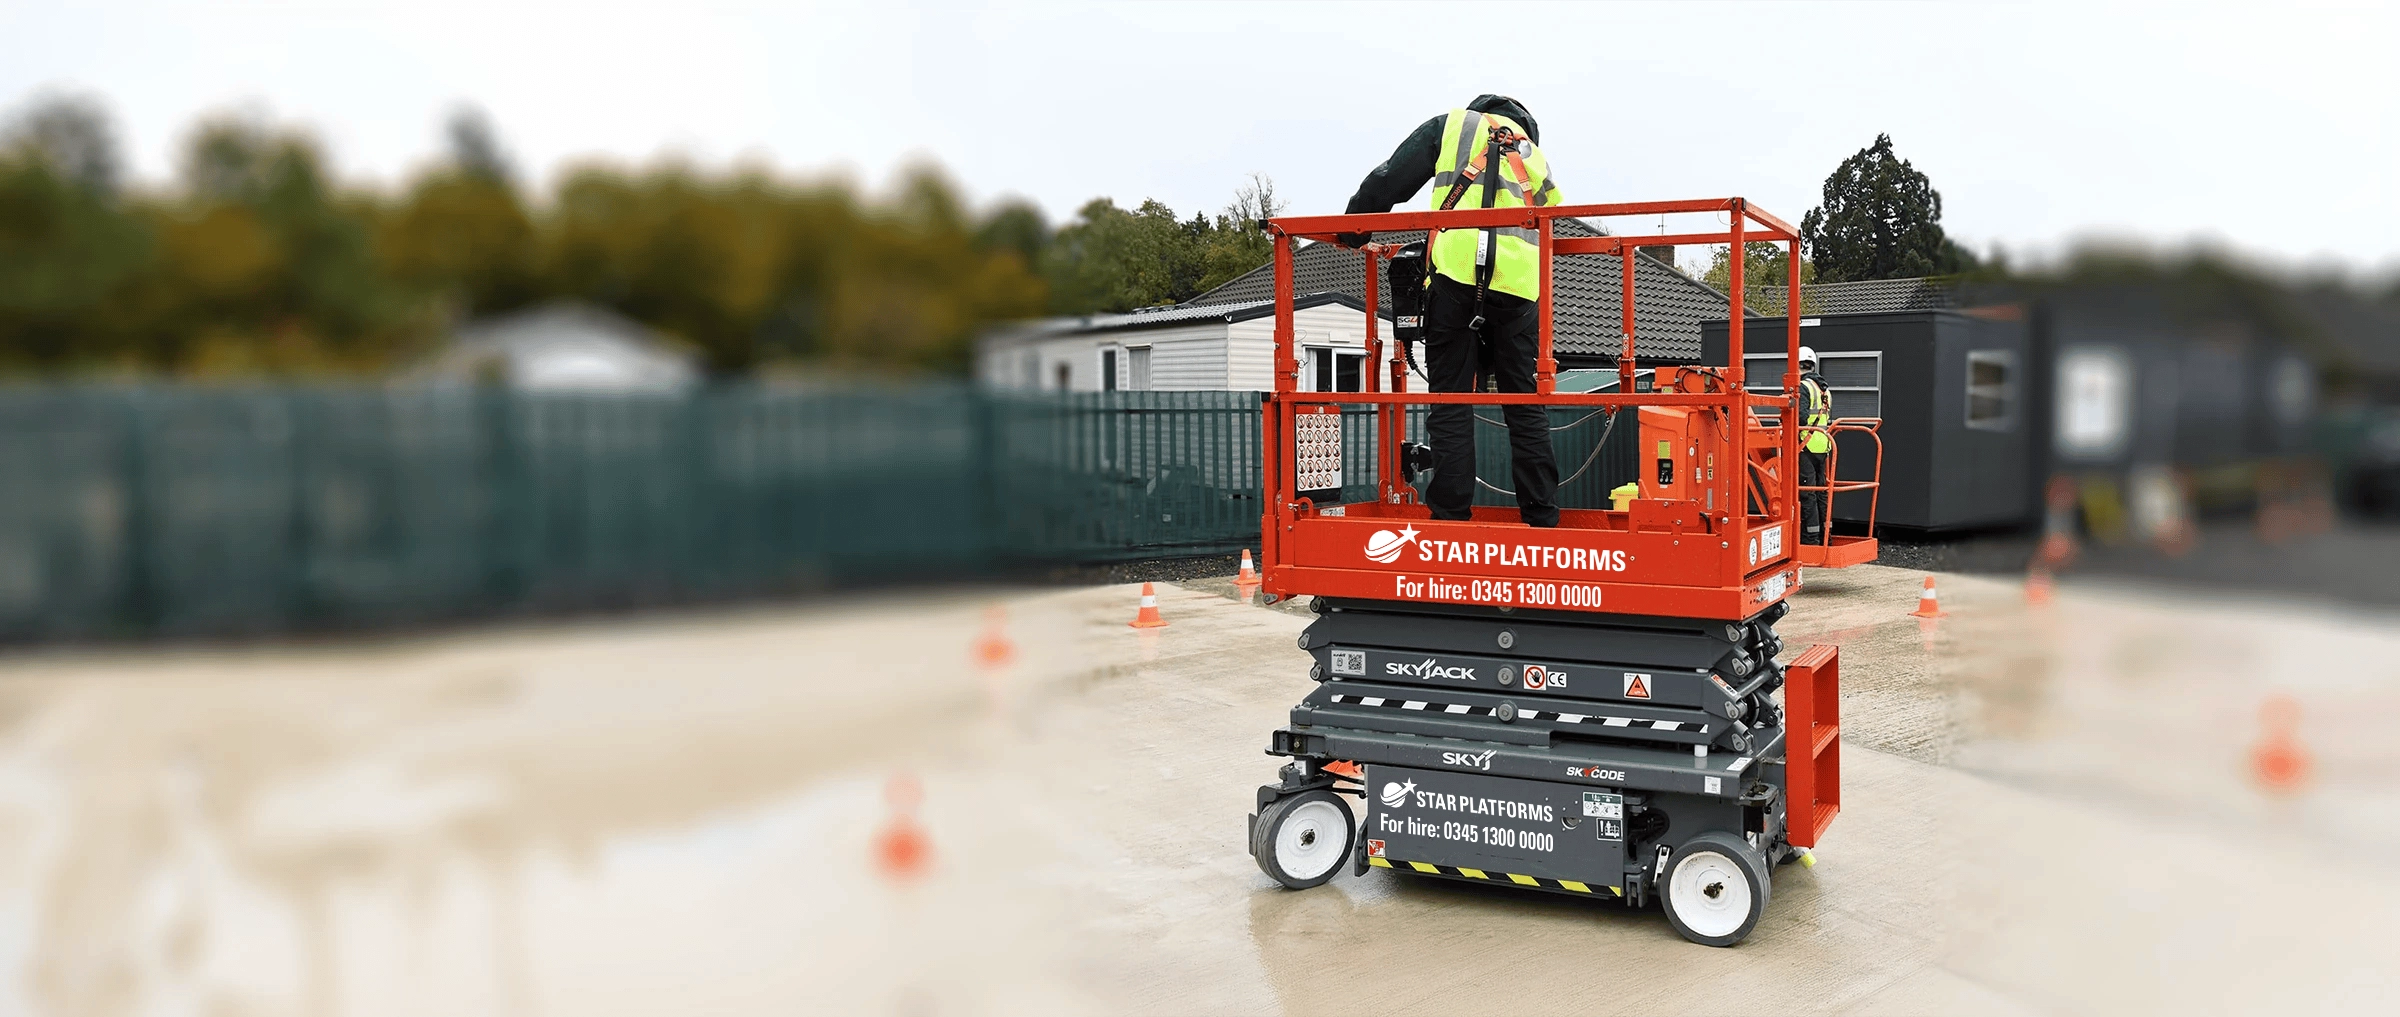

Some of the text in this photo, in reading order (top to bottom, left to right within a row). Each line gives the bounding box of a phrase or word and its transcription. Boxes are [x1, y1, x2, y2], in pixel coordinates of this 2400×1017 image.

[1419, 540, 1626, 571] STAR PLATFORMS
[1397, 576, 1601, 607] For hire: 0345 1300 0000
[1386, 658, 1477, 681] SKYJACK
[1566, 764, 1626, 782] SKYCODE
[1417, 791, 1554, 822] STAR PLATFORMS
[1379, 813, 1554, 852] For hire: 0345 1300 0000
